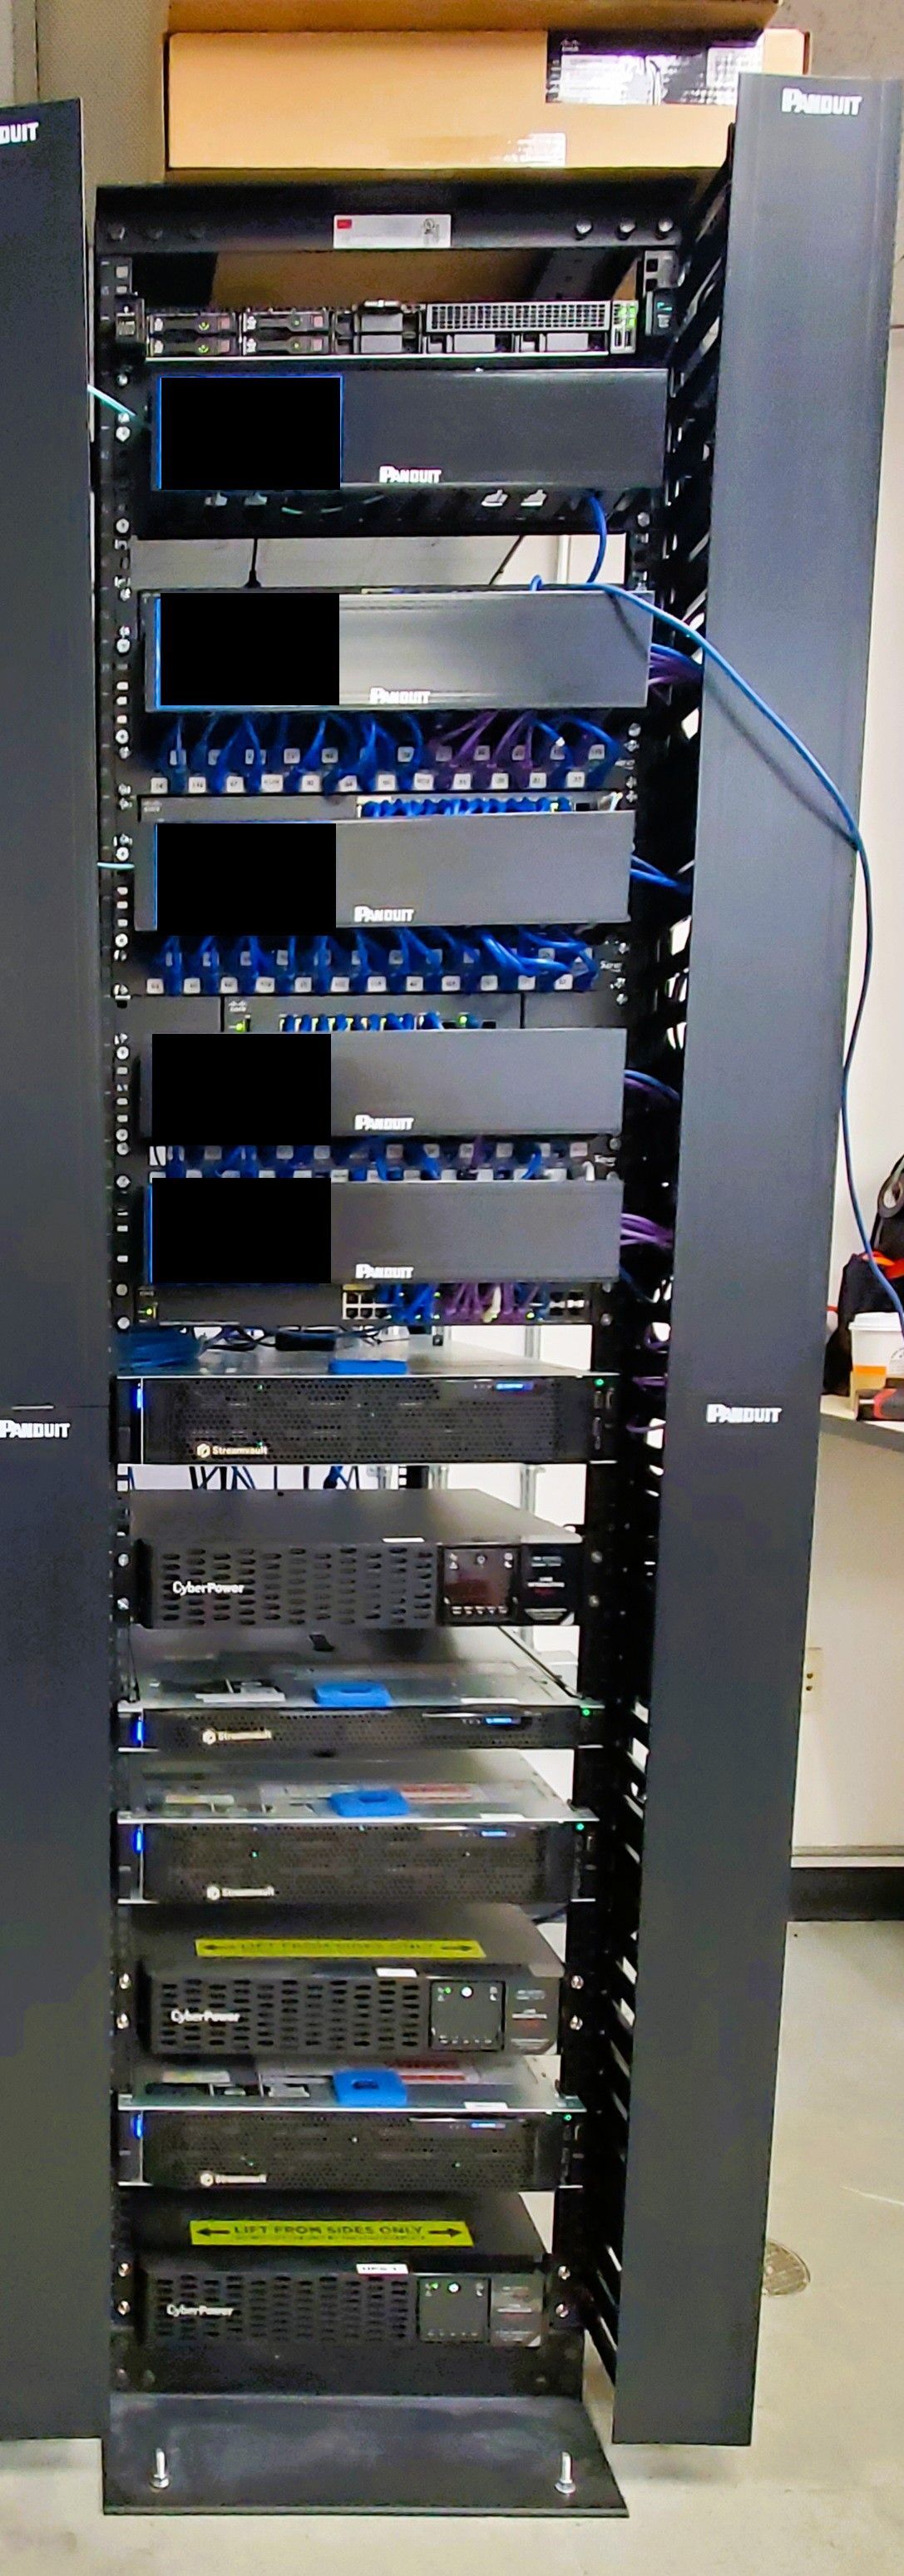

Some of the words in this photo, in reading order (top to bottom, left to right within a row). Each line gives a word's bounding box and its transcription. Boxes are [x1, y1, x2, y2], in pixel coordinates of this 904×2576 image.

[782, 87, 862, 116] PANDUIT
[378, 466, 442, 483] PANDUIT
[368, 687, 431, 705] PANDUIT
[354, 906, 414, 922] PANDUIT
[355, 1115, 414, 1130] PANDUIT
[356, 1263, 413, 1279] PANDUIT
[707, 1404, 782, 1423] PANDUIT
[172, 1580, 245, 1596] CyberPower
[234, 2226, 267, 2234] LIFT
[274, 2226, 322, 2234] FROM
[327, 2226, 373, 2235] SIDES
[379, 2226, 422, 2235] ONLY
